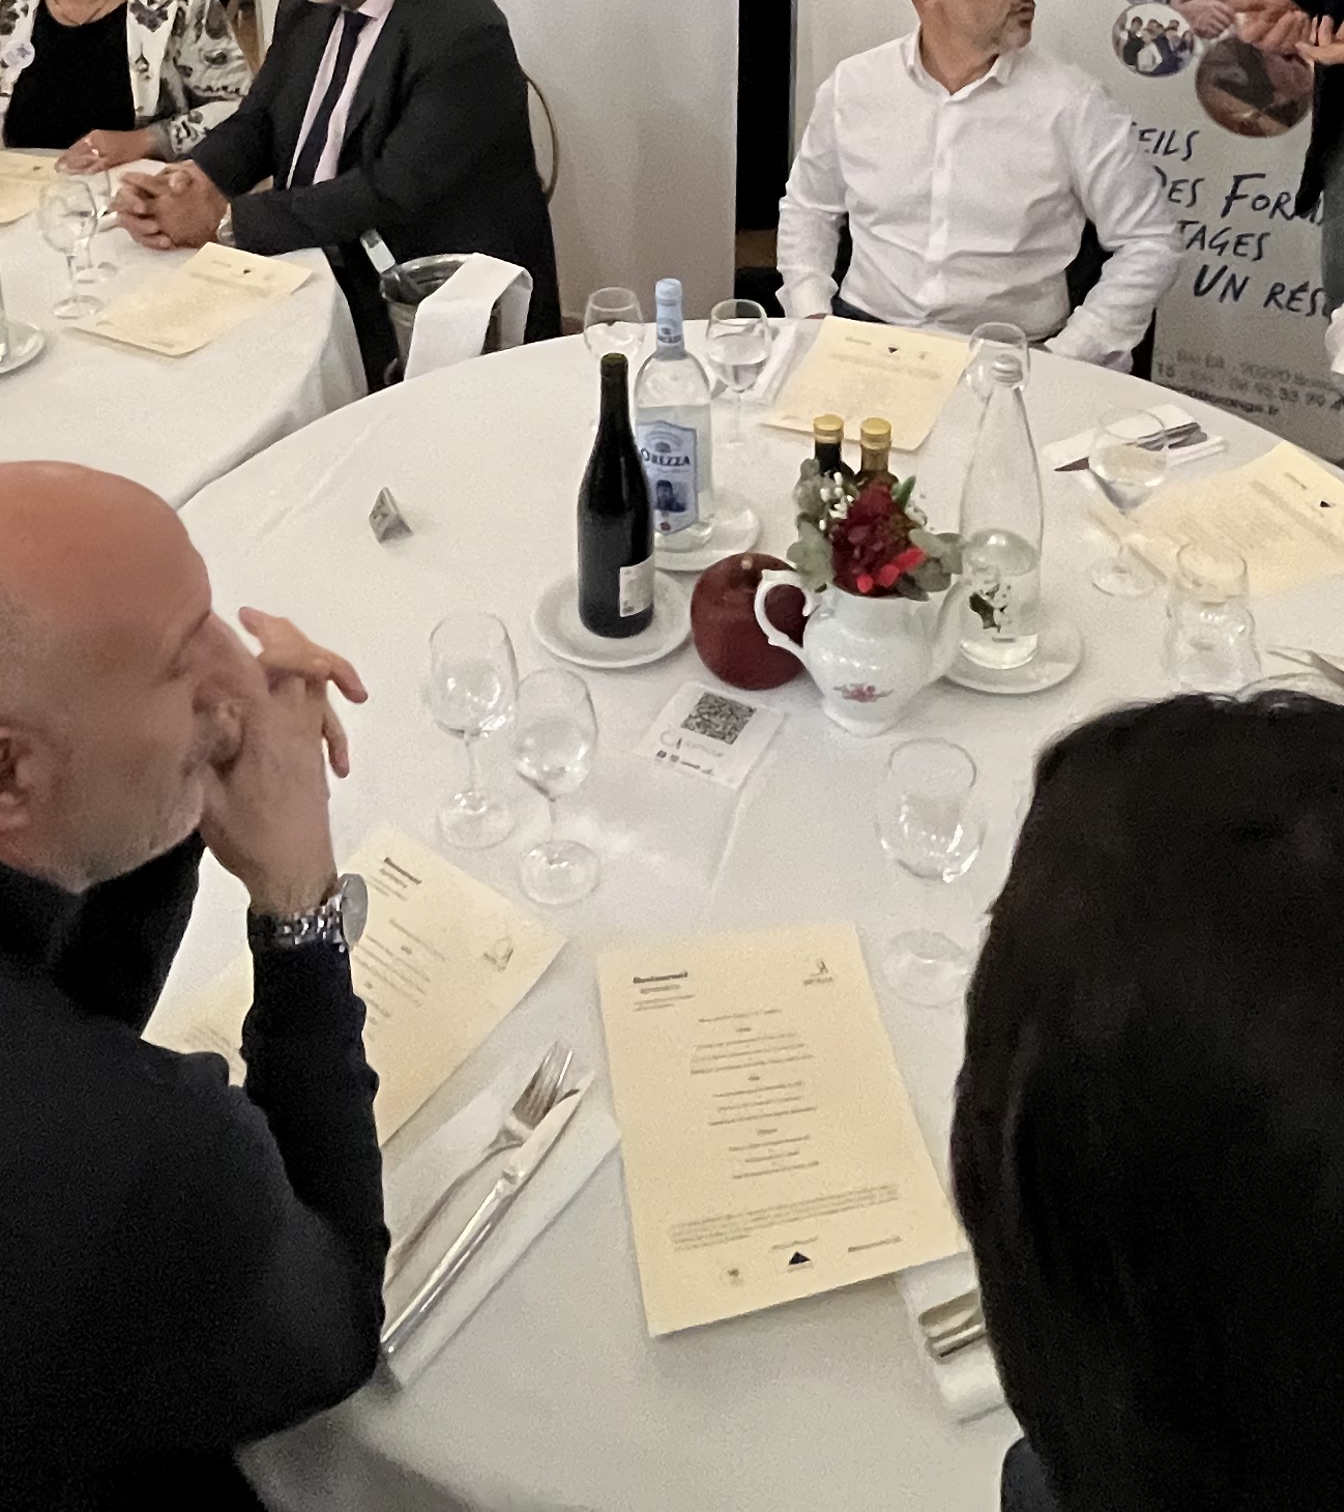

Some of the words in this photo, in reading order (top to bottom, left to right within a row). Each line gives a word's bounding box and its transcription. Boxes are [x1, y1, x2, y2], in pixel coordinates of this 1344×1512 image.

[1132, 121, 1200, 161] EILS
[1177, 219, 1271, 262] TAGES
[1193, 264, 1250, 303] UN
